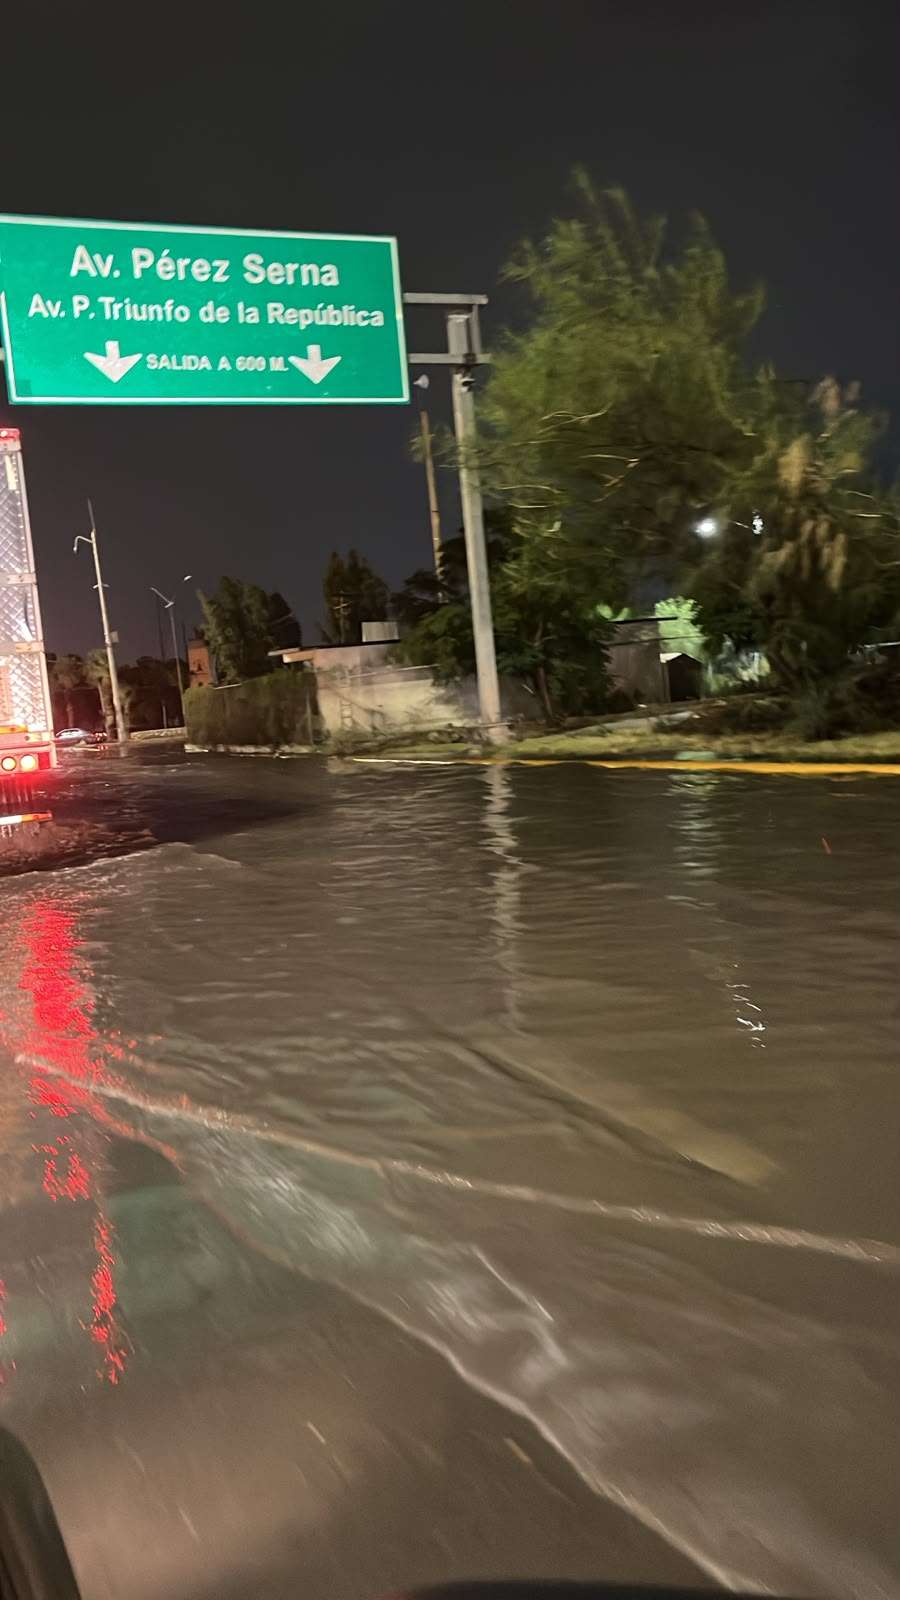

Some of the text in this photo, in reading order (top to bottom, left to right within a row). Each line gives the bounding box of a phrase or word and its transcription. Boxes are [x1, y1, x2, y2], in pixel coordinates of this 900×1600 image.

[69, 244, 340, 287] Av. Pérez Serna
[28, 293, 66, 318] Av.
[97, 296, 191, 322] Triunfo
[199, 300, 231, 323] de
[237, 301, 260, 324] la
[266, 302, 386, 330] República
[146, 353, 213, 371] SALIDA
[217, 356, 232, 371] A
[235, 355, 267, 372] 600
